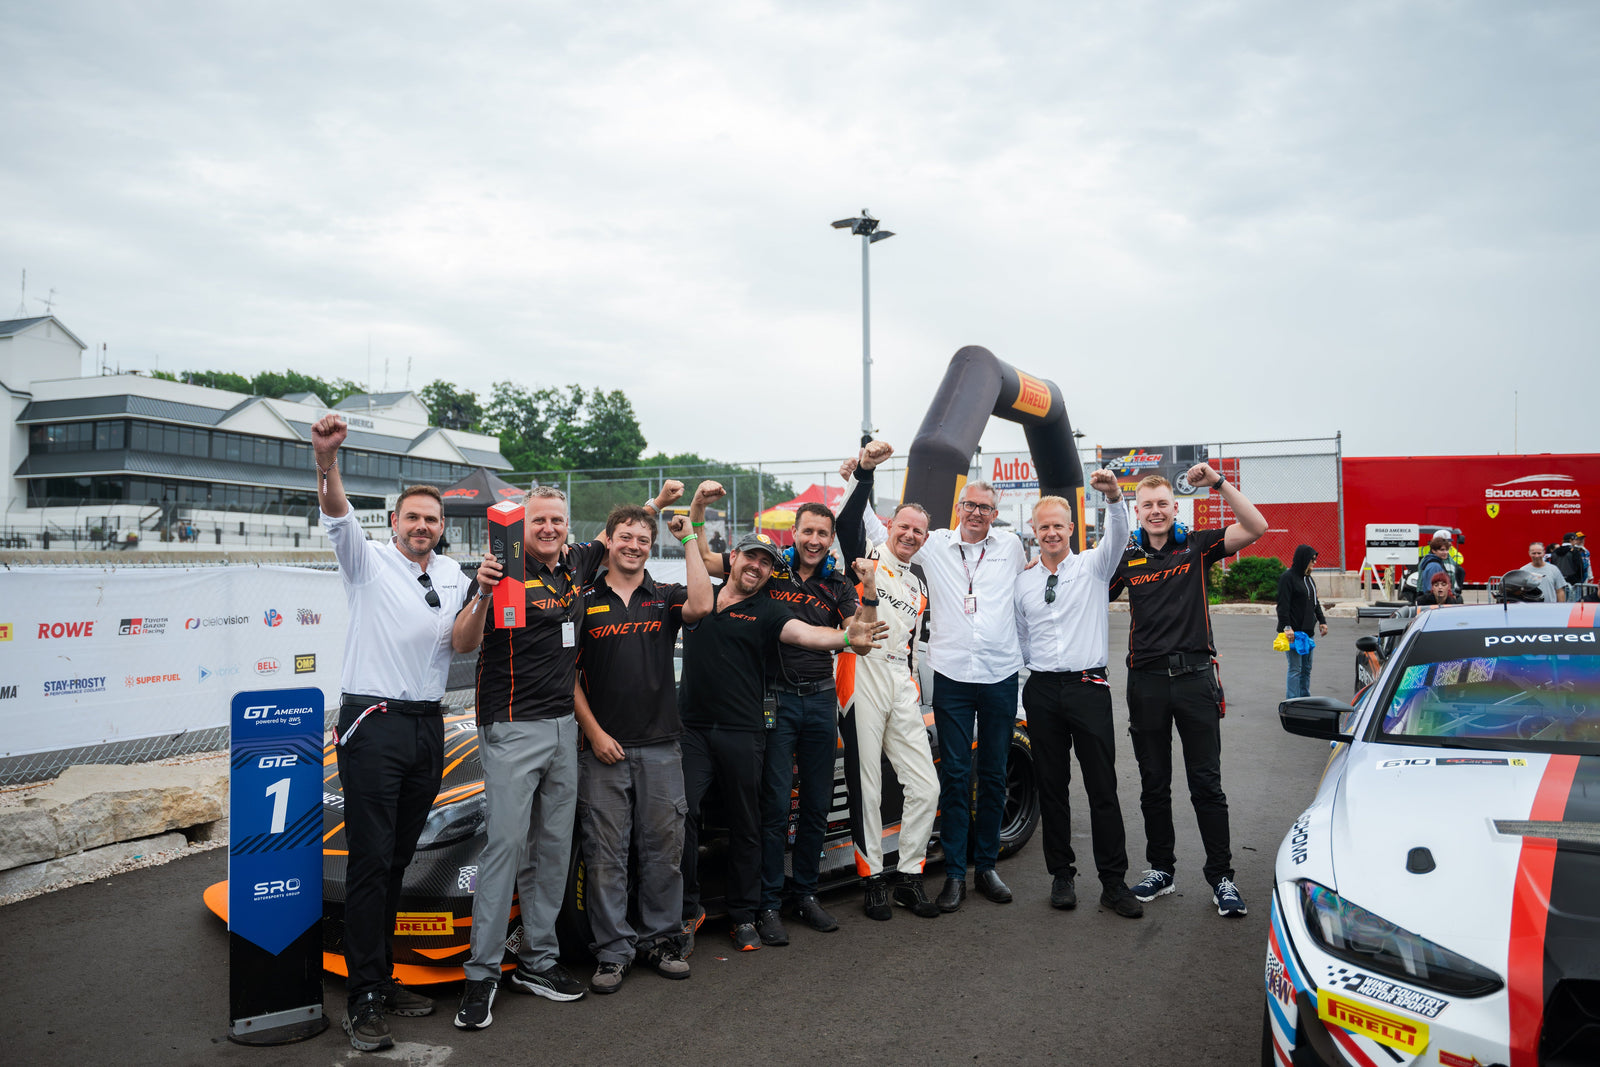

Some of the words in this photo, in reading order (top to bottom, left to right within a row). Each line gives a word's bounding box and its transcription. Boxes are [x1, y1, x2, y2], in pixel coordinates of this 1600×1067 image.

[1020, 377, 1048, 410] PIRELLI
[1485, 488, 1539, 498] SCUDERIA
[1541, 488, 1580, 497] CORSA
[513, 541, 520, 558] 1
[1129, 563, 1191, 586] GINETTA
[119, 624, 142, 635] GR
[202, 615, 249, 628] cielovision
[588, 620, 662, 639] GINETTA
[37, 621, 94, 639] ROWE
[1484, 631, 1596, 647] powered
[257, 661, 278, 671] BELL
[296, 659, 315, 669] OMP
[136, 675, 161, 685] SUPER
[162, 673, 181, 682] FUEL
[243, 705, 277, 720] GT
[274, 707, 313, 716] AMERICA
[255, 717, 279, 726] powered
[288, 716, 302, 726] aws
[258, 754, 298, 769] GT2
[265, 777, 291, 834] 1
[254, 878, 301, 896] SRO
[254, 893, 284, 901] MOTORSPORTS
[1363, 976, 1390, 991] WINE
[1390, 983, 1446, 1009] COUNTRY
[1356, 985, 1393, 1004] MOTOR
[1393, 994, 1439, 1017] SPORTS
[1327, 998, 1417, 1047] PIRELLI
